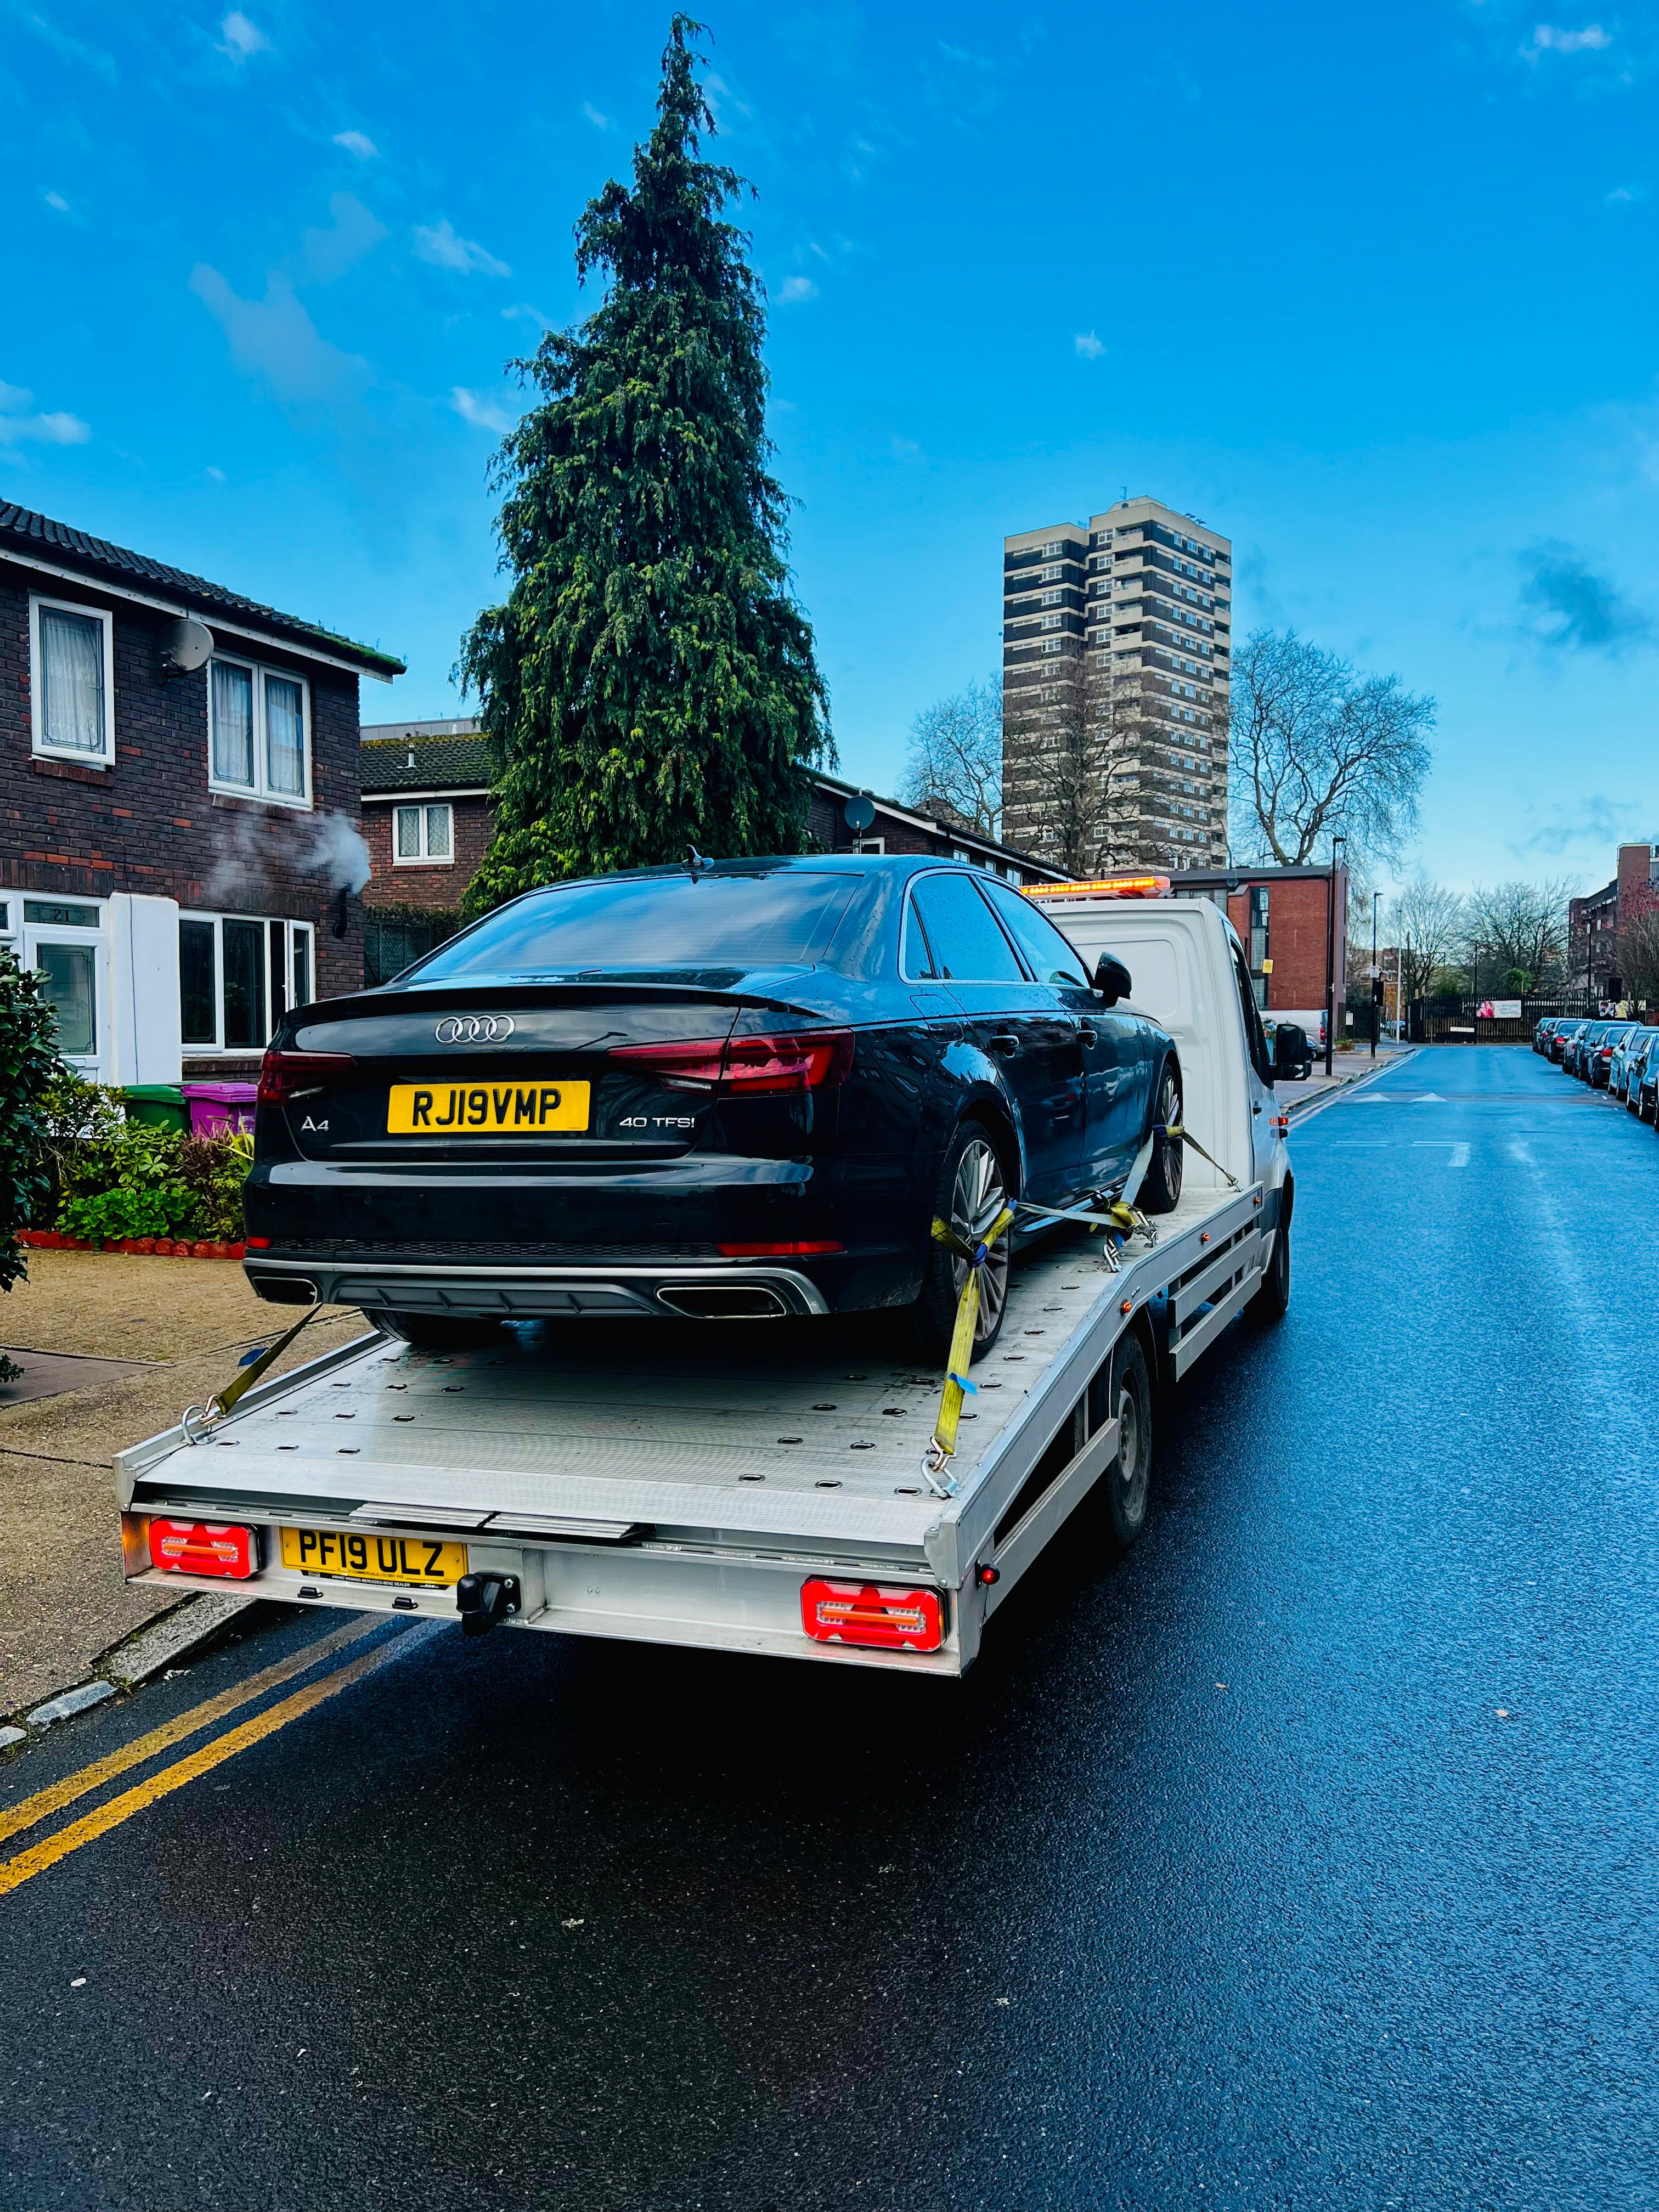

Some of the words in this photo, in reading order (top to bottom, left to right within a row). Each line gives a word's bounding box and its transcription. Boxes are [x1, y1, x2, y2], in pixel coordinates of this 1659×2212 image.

[53, 908, 70, 922] 21
[412, 1088, 561, 1126] RJ19VMP
[300, 1116, 329, 1132] A4
[619, 1117, 647, 1127] 40
[652, 1117, 695, 1128] TFSI
[298, 1529, 368, 1570] PF19
[376, 1538, 444, 1577] ULZ
